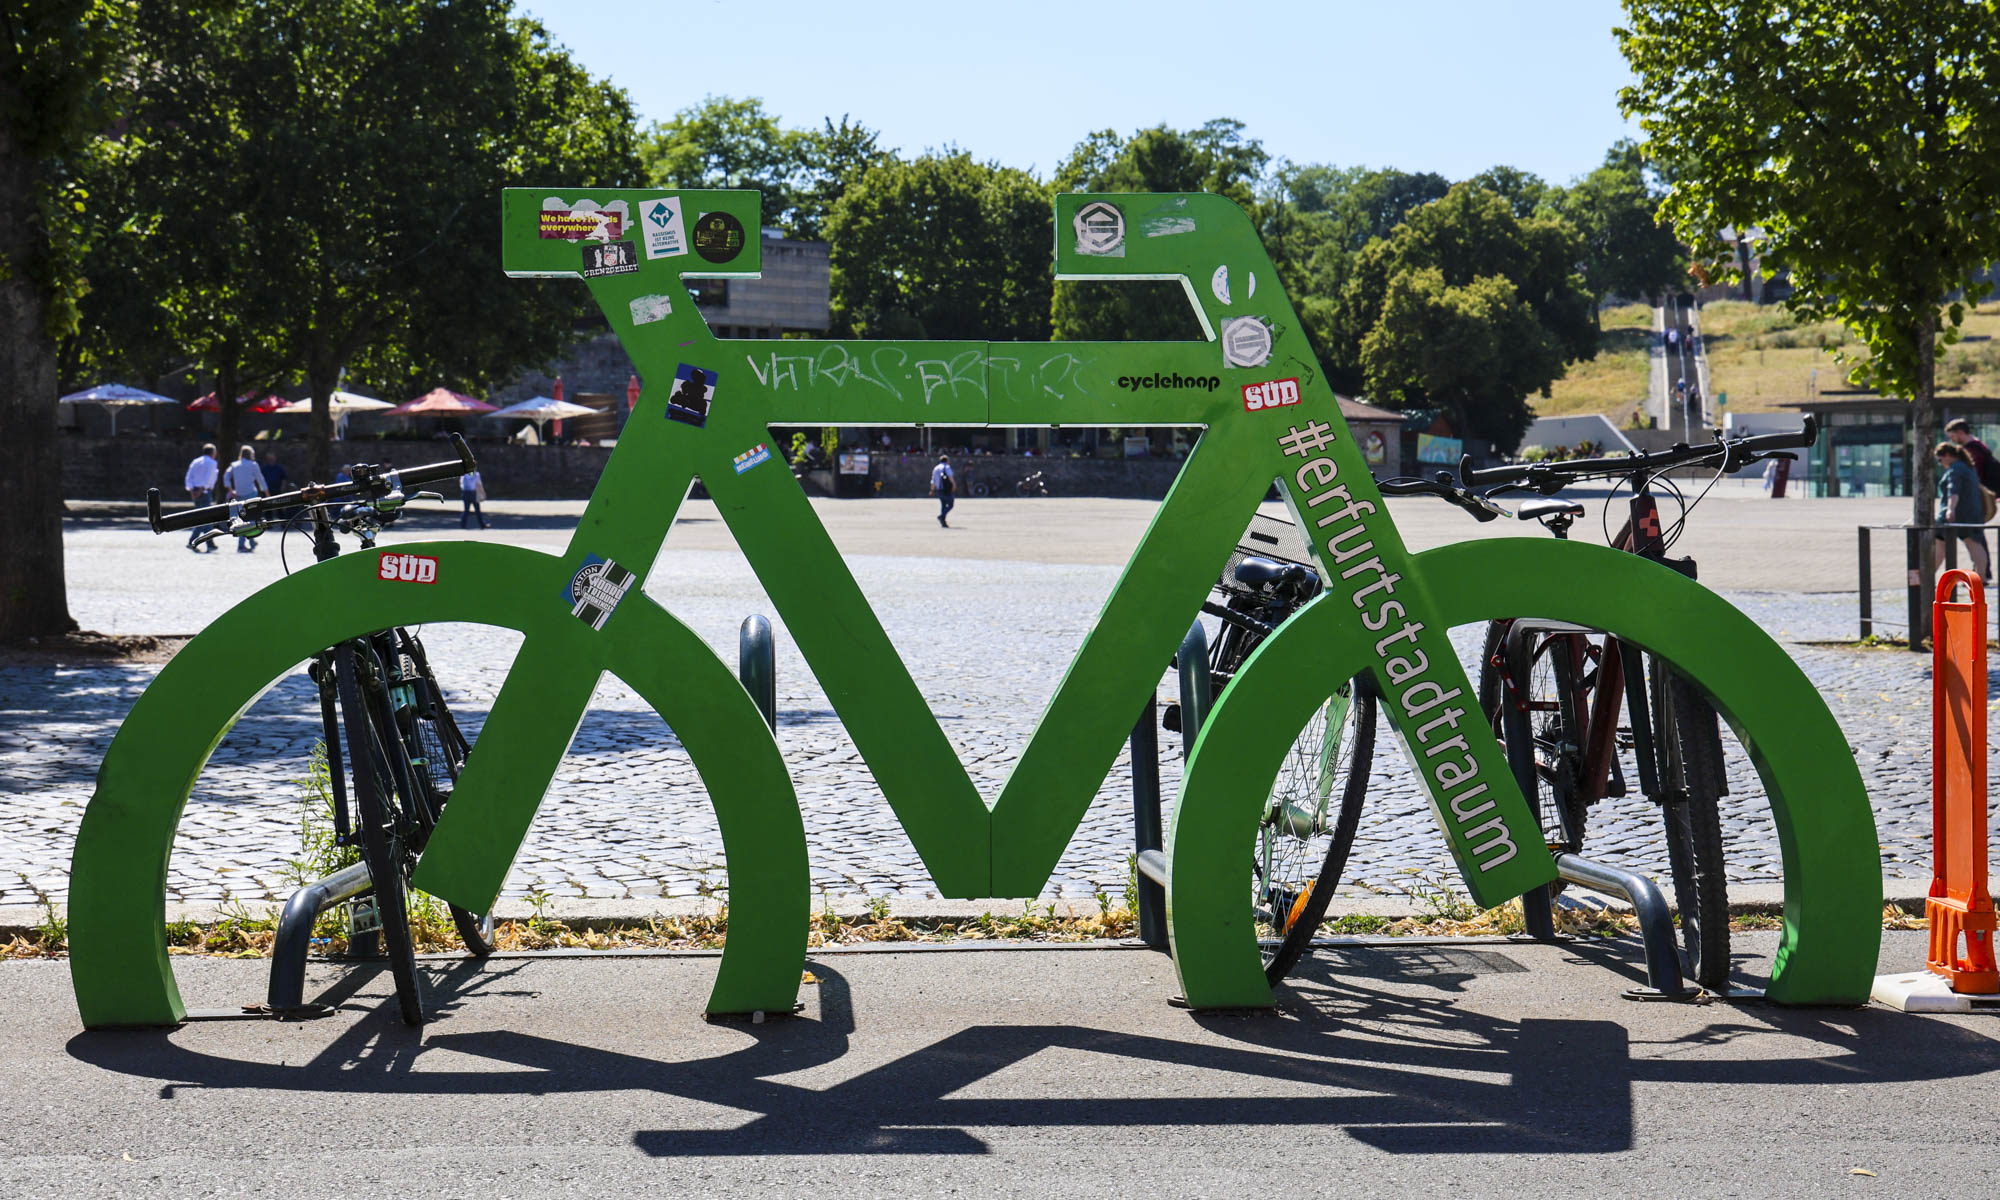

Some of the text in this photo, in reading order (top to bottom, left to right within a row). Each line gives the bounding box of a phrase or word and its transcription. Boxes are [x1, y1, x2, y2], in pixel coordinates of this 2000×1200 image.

[541, 214, 556, 222] We
[584, 264, 638, 277] GRENZGEBIET
[1118, 372, 1220, 392] cyclehoop
[1245, 381, 1299, 410] SÜD
[380, 554, 436, 582] SÜD
[574, 566, 598, 597] SEKTION
[1277, 420, 1519, 873] #erfurtstadtraum
